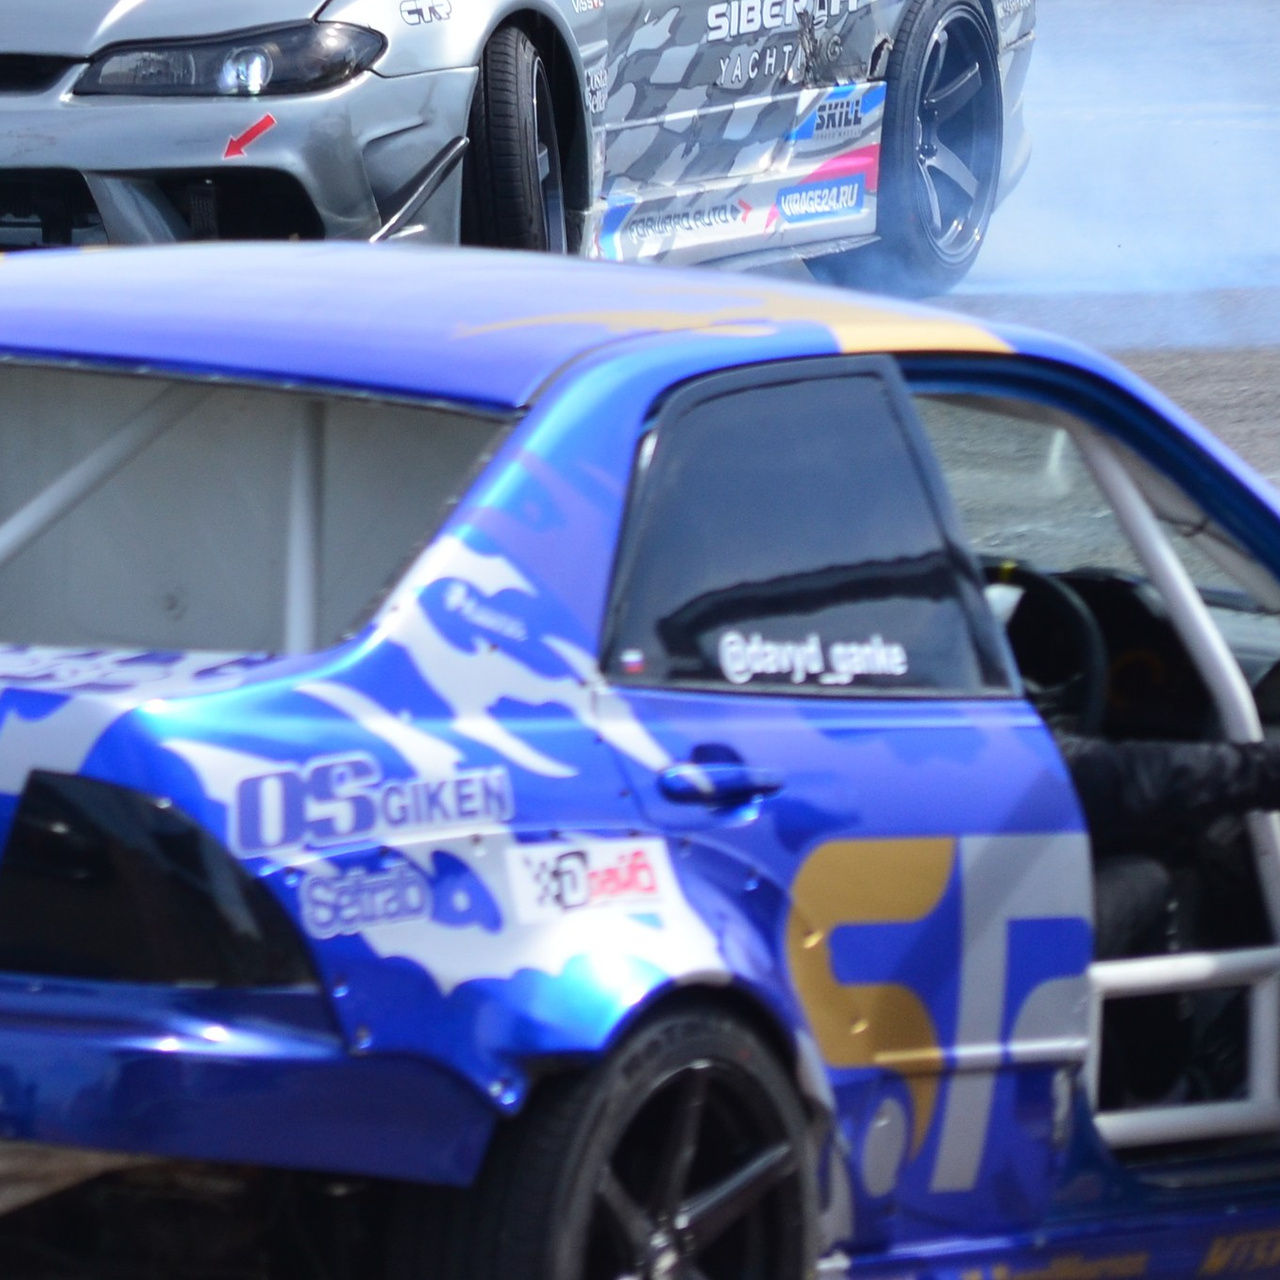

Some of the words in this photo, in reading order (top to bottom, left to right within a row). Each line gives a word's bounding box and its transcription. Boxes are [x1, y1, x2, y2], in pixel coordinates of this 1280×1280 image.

[815, 99, 863, 132] SKILL
[694, 204, 728, 228] AUTO
[781, 183, 859, 217] VIRAGE24.RU
[236, 756, 379, 855] OS
[381, 773, 510, 824] GIKEN
[306, 870, 424, 928] Setrab
